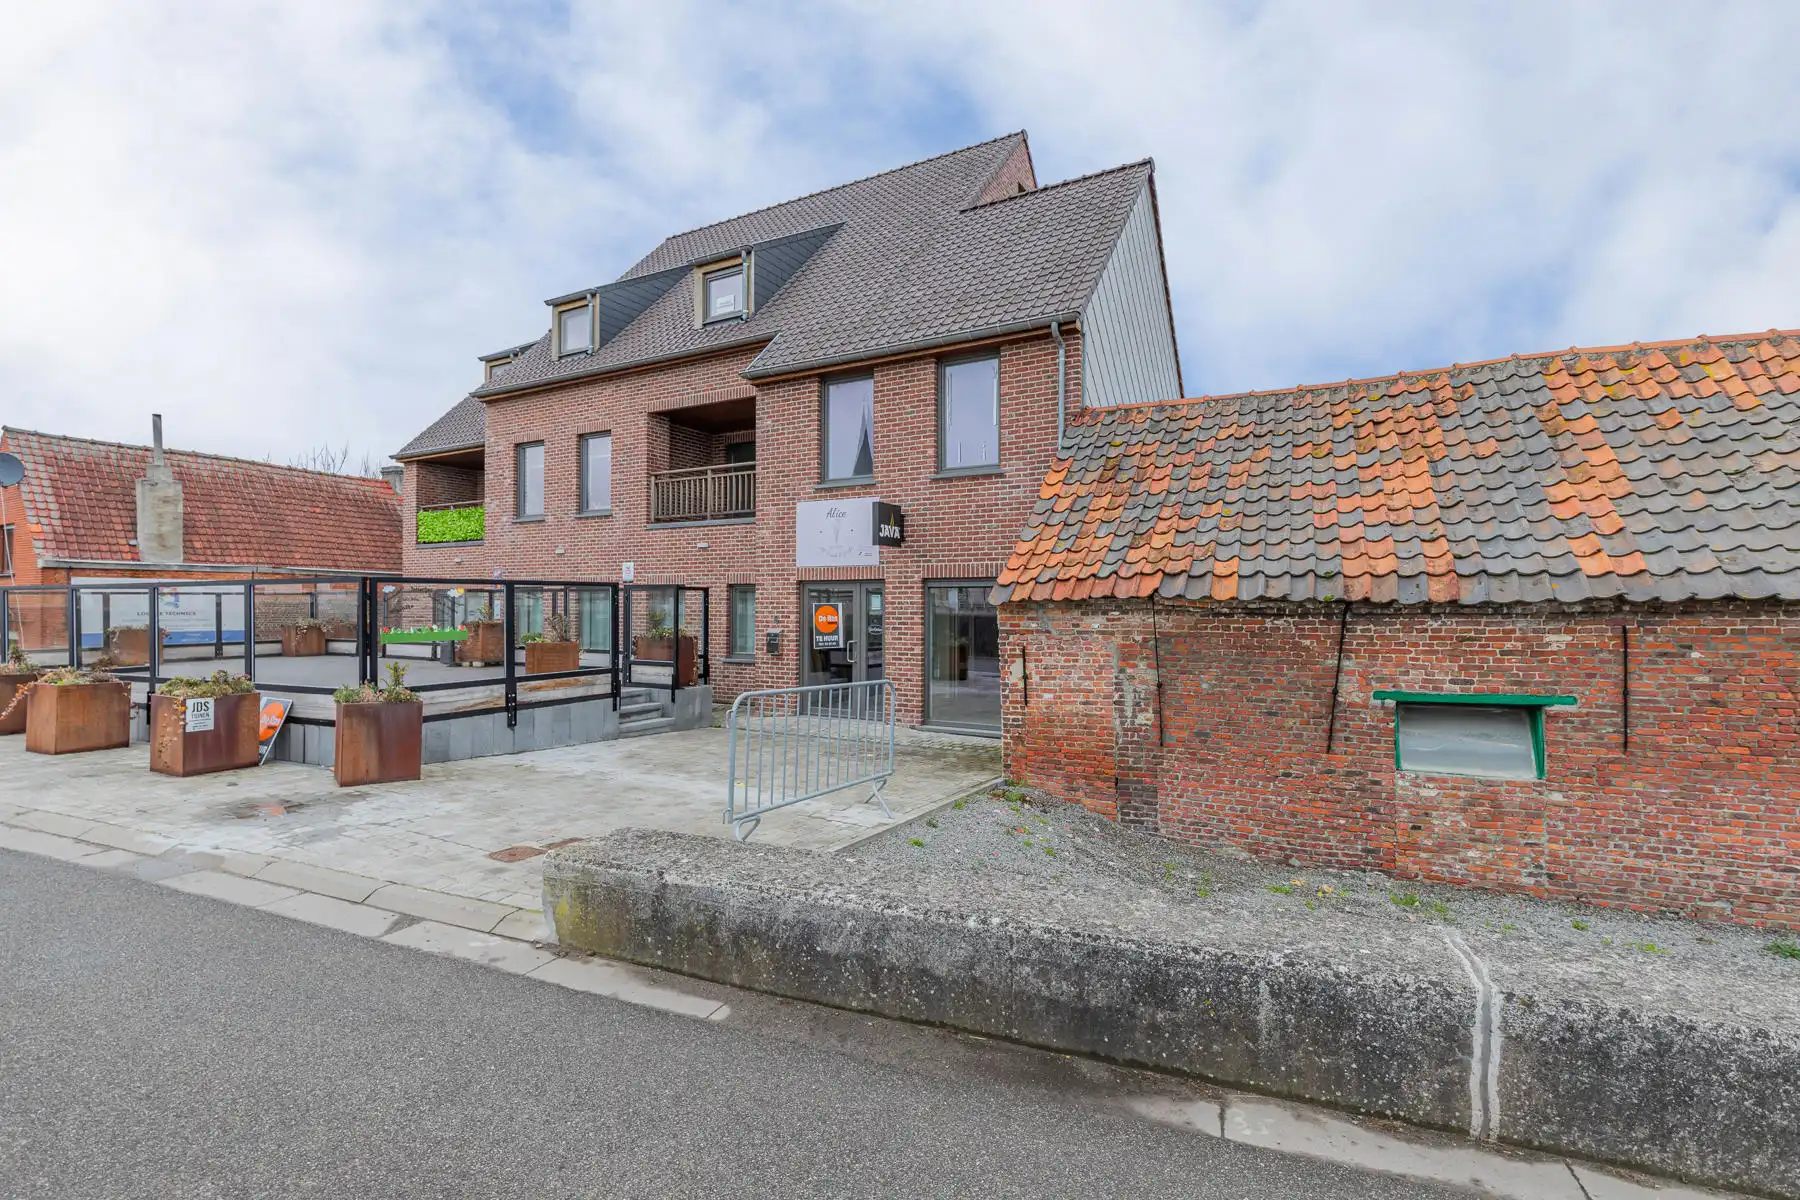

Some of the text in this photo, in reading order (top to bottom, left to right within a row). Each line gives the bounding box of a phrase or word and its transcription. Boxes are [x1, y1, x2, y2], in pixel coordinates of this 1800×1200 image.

[826, 508, 847, 519] Alice
[880, 524, 901, 538] JAVA
[192, 701, 209, 713] JDS
